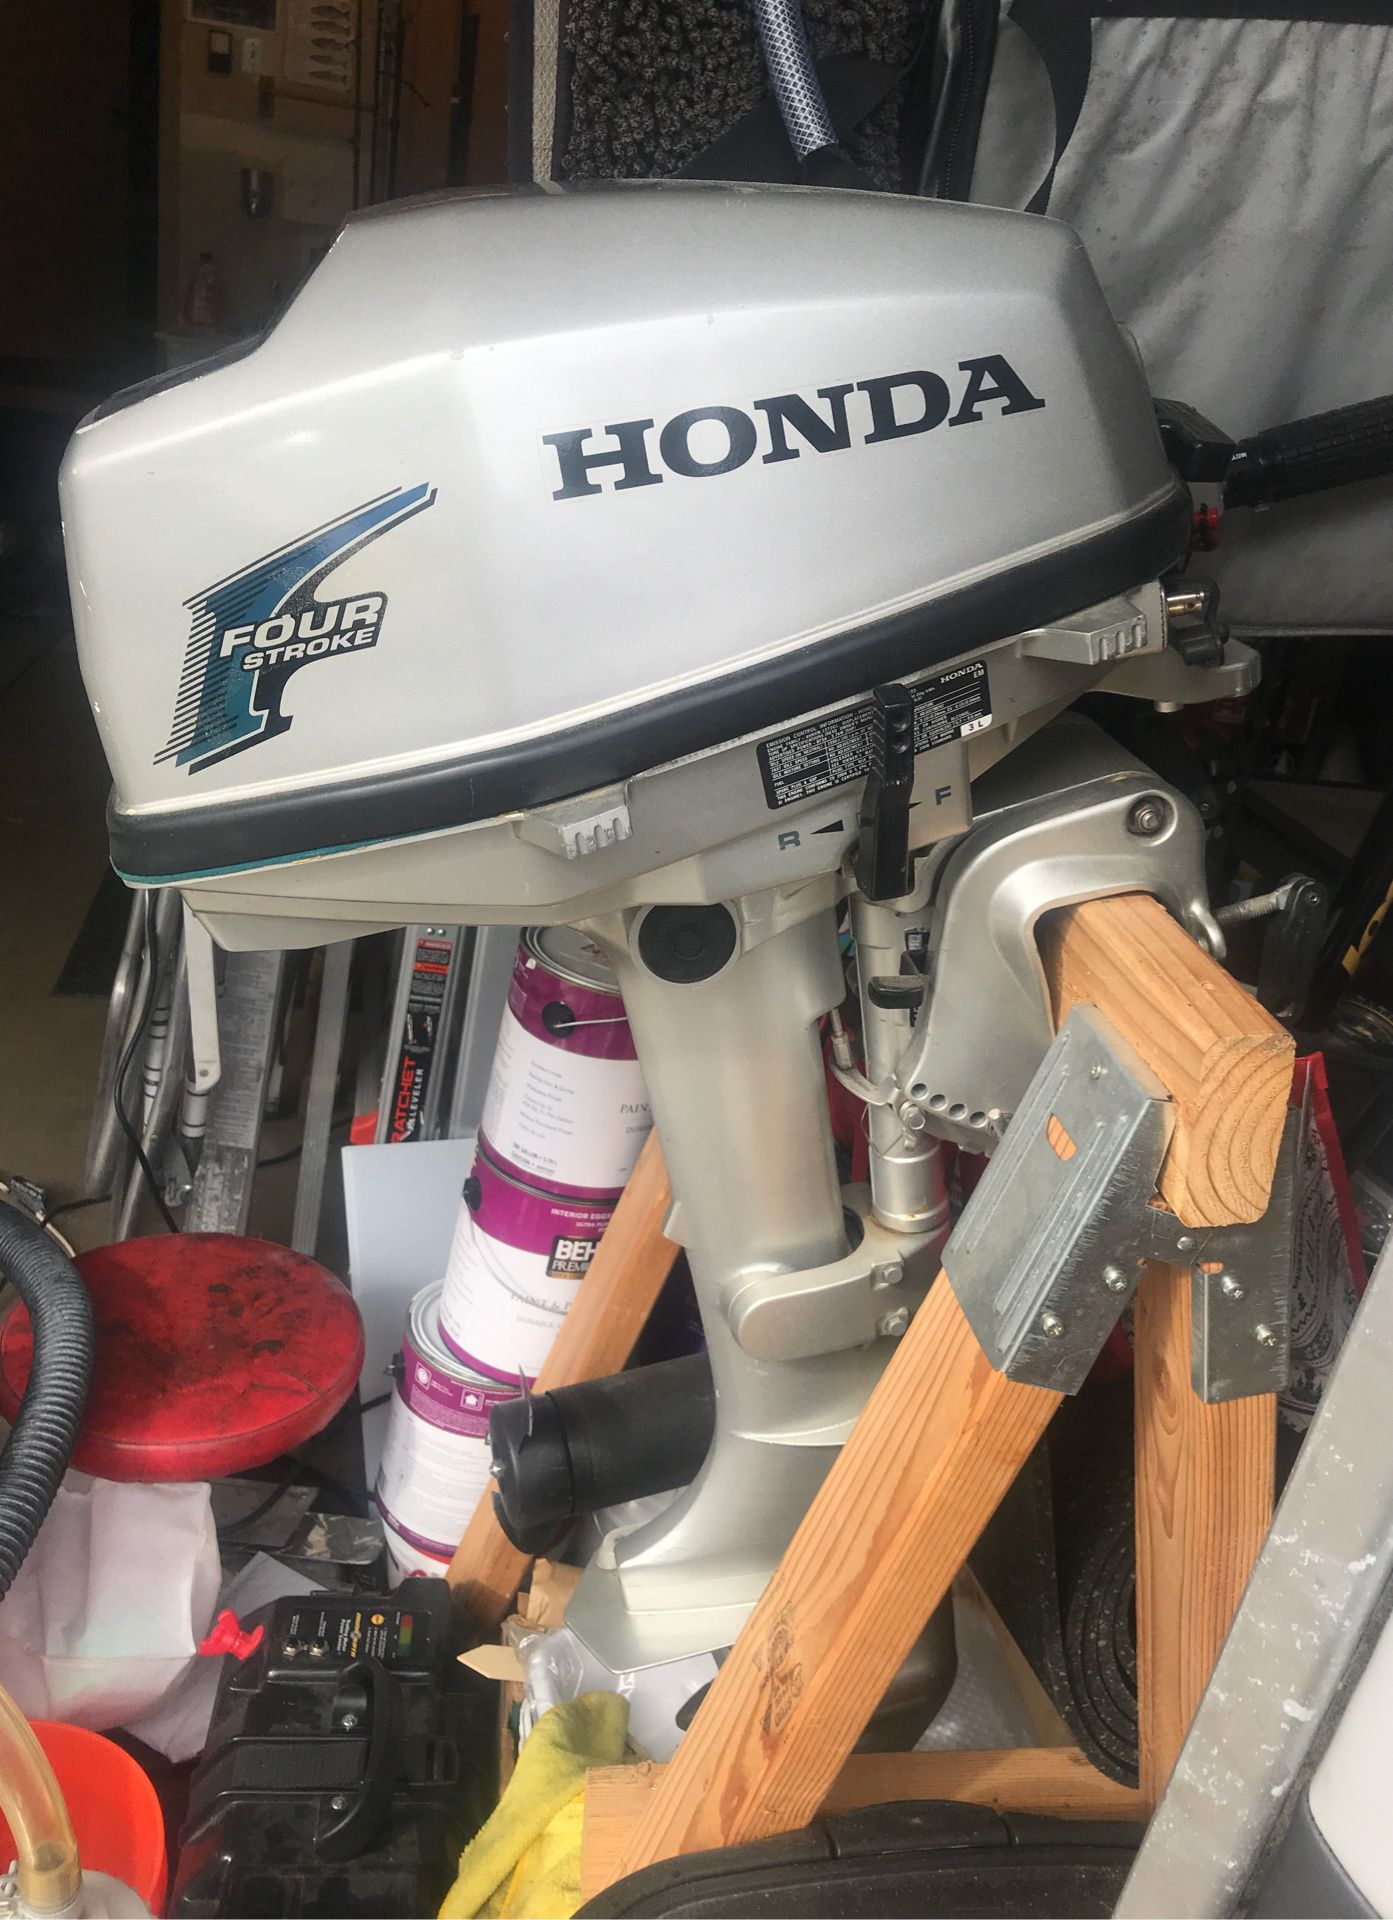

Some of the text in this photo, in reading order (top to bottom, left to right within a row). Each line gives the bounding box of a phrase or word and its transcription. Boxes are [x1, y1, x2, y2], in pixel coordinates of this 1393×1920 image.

[542, 354, 1045, 501] HONDA
[219, 596, 383, 658] FOUR
[243, 626, 376, 670] STROKE
[940, 662, 984, 684] HONDA
[973, 668, 985, 679] EM
[765, 735, 790, 748] EMISSION
[793, 726, 816, 738] CONTROL
[819, 712, 852, 728] INFORMATION
[968, 720, 984, 732] 3 L
[935, 785, 951, 805] F
[778, 830, 801, 850] R
[391, 1055, 416, 1143] RATCHET
[409, 1068, 424, 1118] LEVELER
[551, 1208, 589, 1220] INTERIOR
